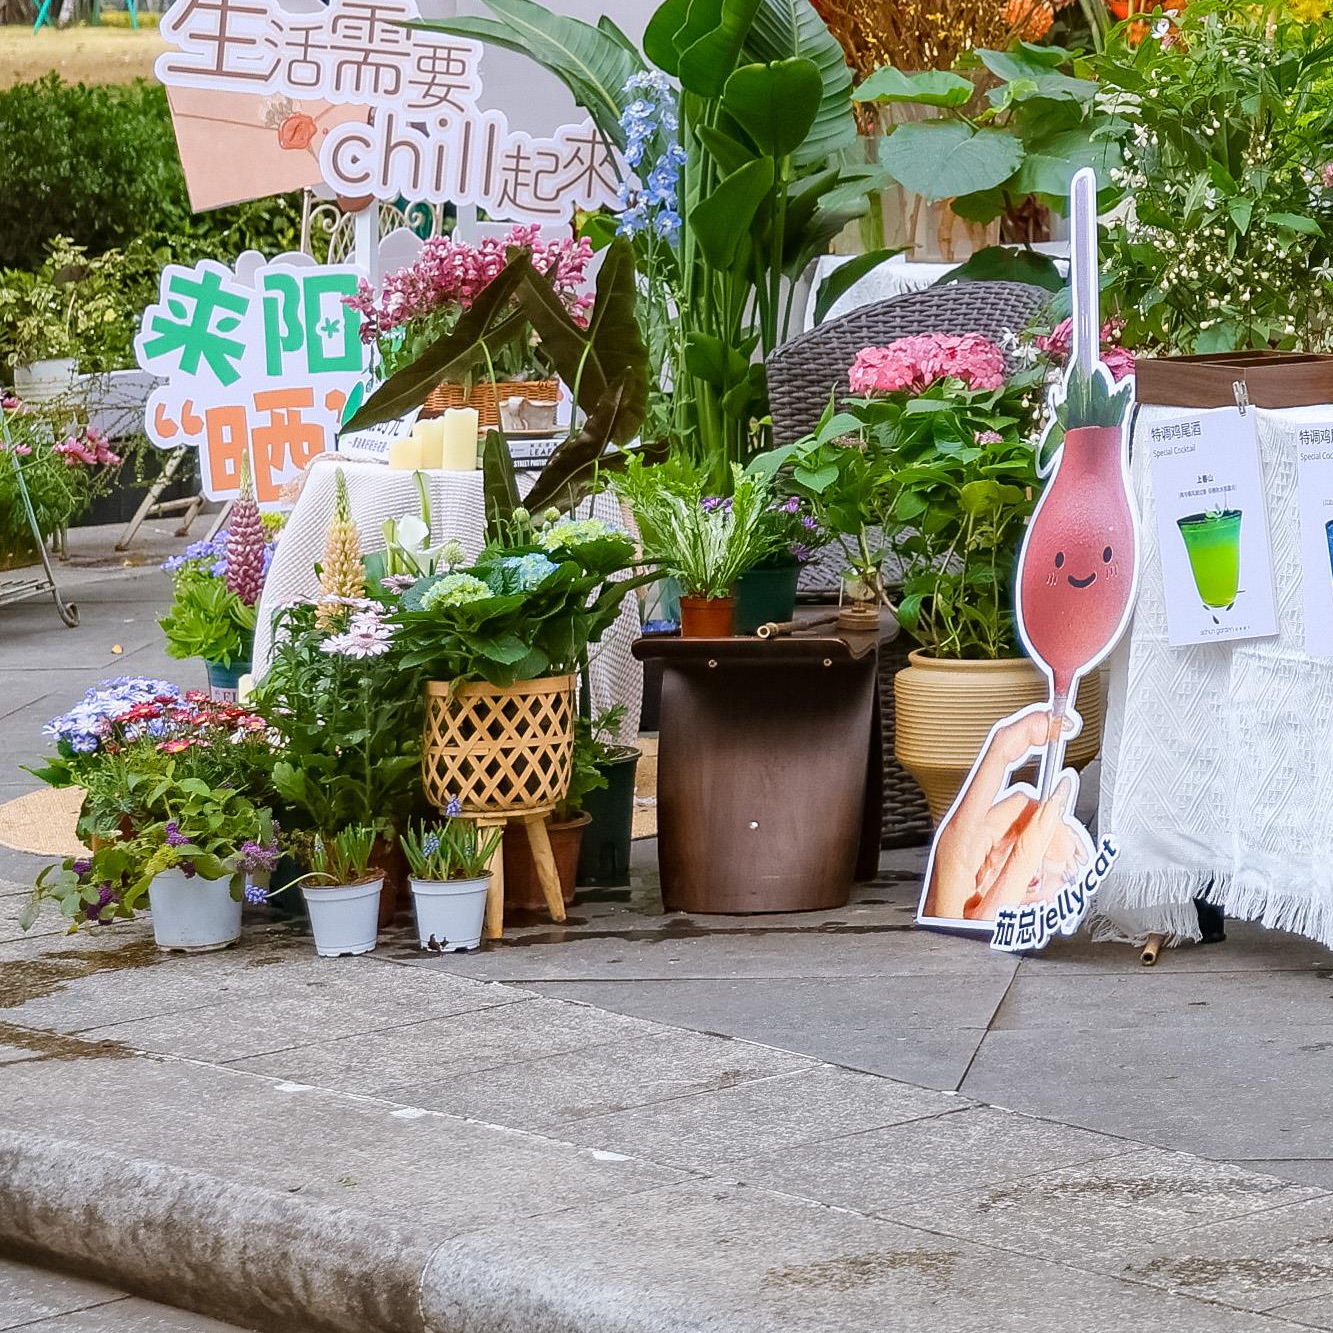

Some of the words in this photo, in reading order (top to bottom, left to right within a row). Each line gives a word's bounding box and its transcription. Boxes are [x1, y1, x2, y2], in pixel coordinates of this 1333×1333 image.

[1151, 421, 1201, 442] 特调鸡尾酒
[1300, 452, 1321, 462] Special
